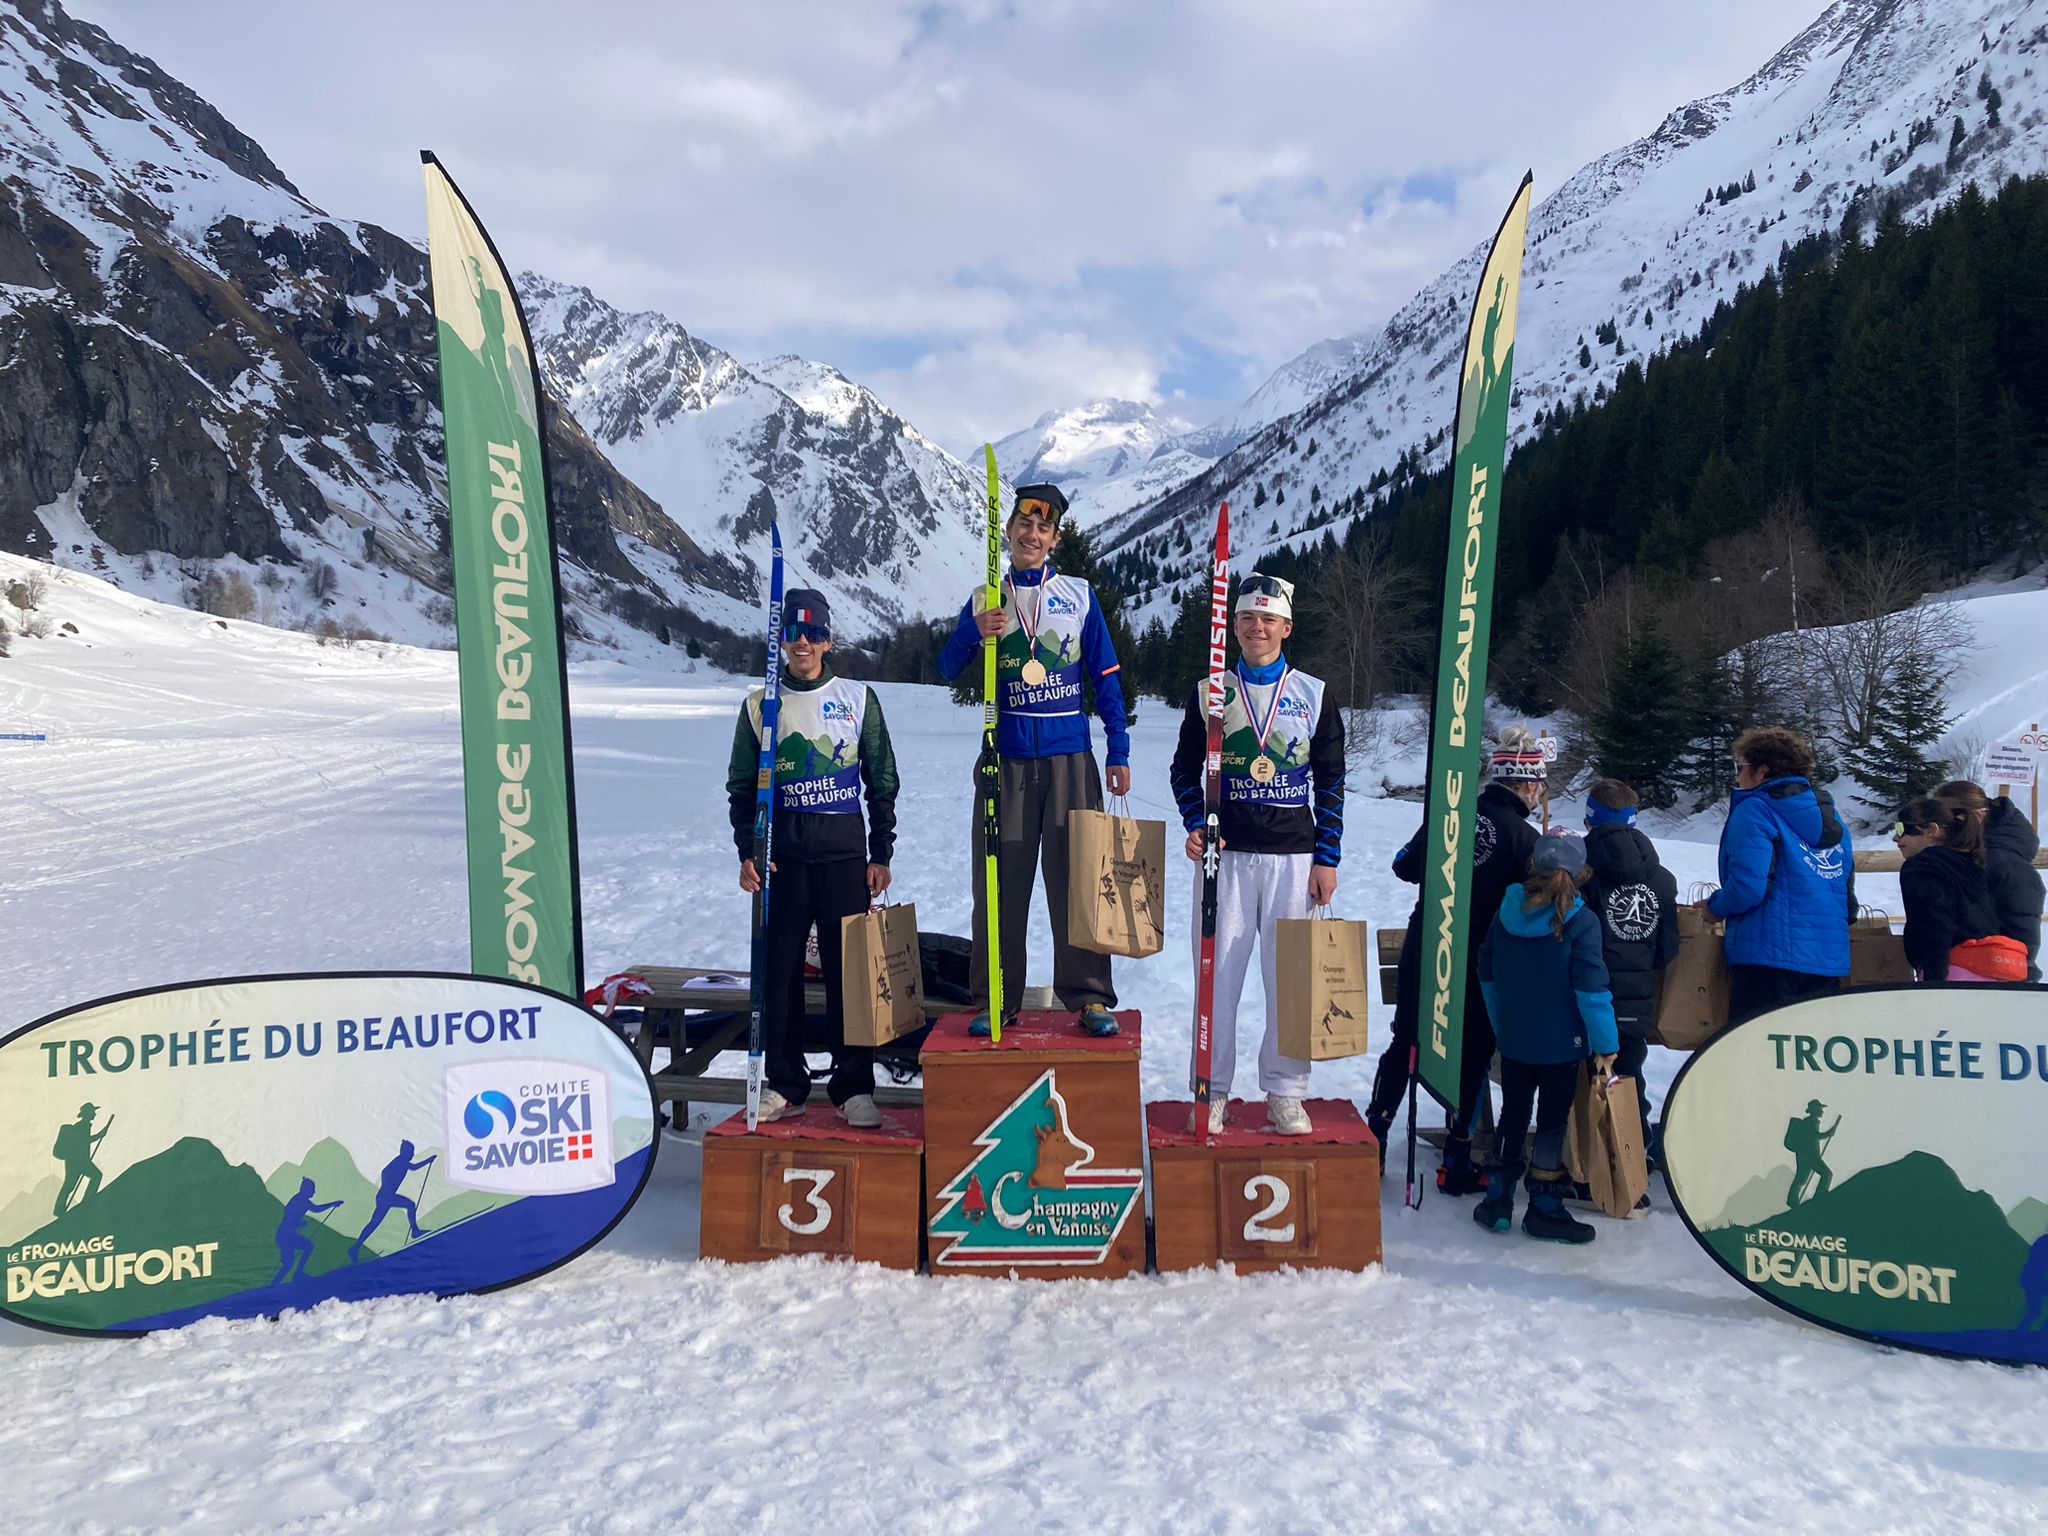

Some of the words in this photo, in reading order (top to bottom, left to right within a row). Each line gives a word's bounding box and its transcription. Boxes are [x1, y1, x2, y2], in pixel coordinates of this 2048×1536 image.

[988, 495, 998, 589] FISCHER
[766, 600, 782, 684] SALOMON
[1208, 558, 1229, 719] MADSHUS
[1009, 694, 1026, 707] DU
[1028, 683, 1081, 704] BEAUFORT
[1257, 762, 1268, 774] 2
[1432, 770, 1464, 1060] FROMAGE
[1450, 463, 1488, 748] BEAUFORT
[781, 776, 837, 796] TROPHÉE
[784, 796, 799, 807] DU
[801, 786, 857, 807] BEAUFORT
[1230, 790, 1248, 800] DU
[1251, 783, 1308, 800] BEAUFORT
[1608, 888, 1621, 906] SKI
[1620, 883, 1660, 910] NORDIQUE
[40, 1019, 251, 1078] TROPHÉE
[264, 1022, 323, 1059] DU
[336, 1006, 543, 1054] BEAUFORT
[1200, 1014, 1209, 1052] REDLINE
[1767, 1030, 1985, 1080] TROPHÉE
[520, 1079, 590, 1098] COMITE
[520, 1093, 592, 1137] SKI
[464, 1137, 565, 1171] SAVOIE
[777, 1168, 835, 1235] 3
[992, 1171, 1120, 1230] Champagny
[1242, 1174, 1296, 1241] 2
[1026, 1222, 1046, 1236] en
[1048, 1216, 1112, 1236] Vanoise
[1745, 1233, 1757, 1244] LE
[1759, 1229, 1848, 1253] FROMAGE
[7, 1252, 19, 1264] LE
[22, 1235, 115, 1261] FROMAGE
[7, 1242, 219, 1303] BEAUFORT
[1745, 1247, 1958, 1304] BEAUFORT
